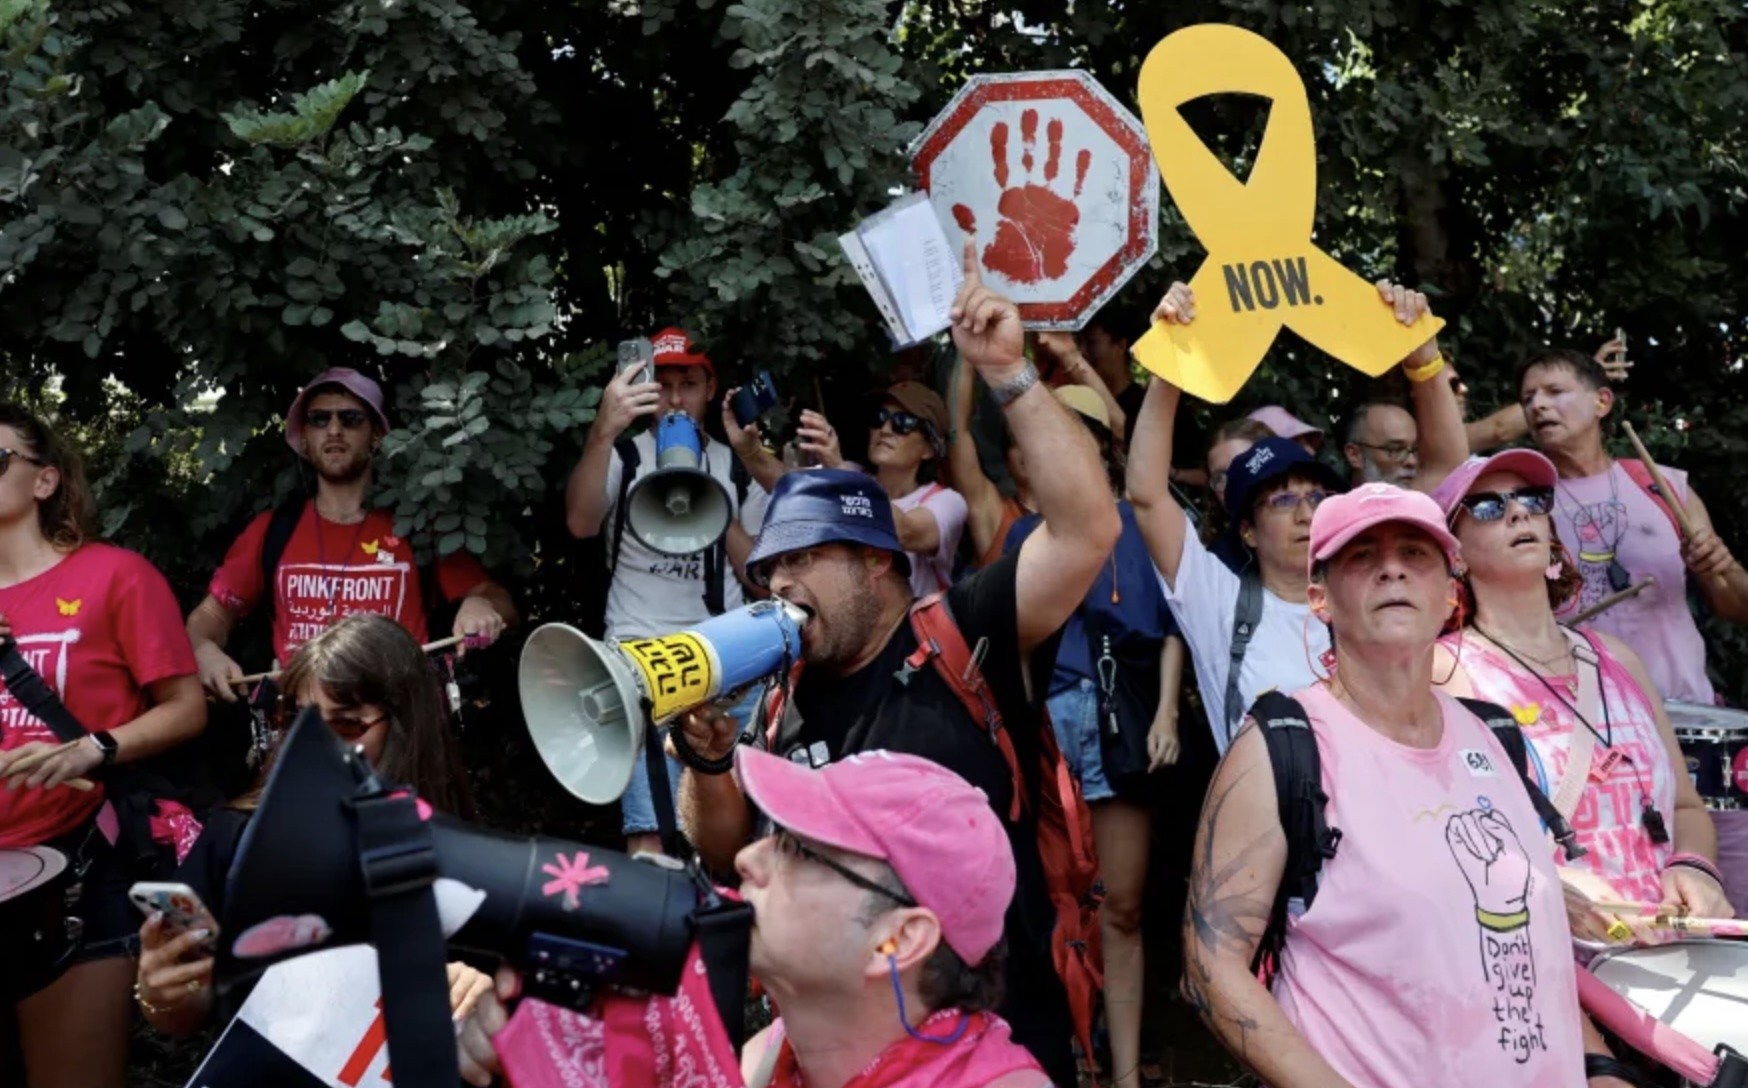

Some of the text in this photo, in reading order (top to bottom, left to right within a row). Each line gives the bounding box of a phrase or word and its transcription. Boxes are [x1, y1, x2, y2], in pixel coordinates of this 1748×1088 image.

[1222, 256, 1324, 313] NOW.
[1486, 933, 1528, 958] Don't
[1492, 957, 1531, 991] give
[1492, 996, 1530, 1023] the
[1508, 984, 1533, 1011] up
[1497, 1012, 1547, 1064] fight
